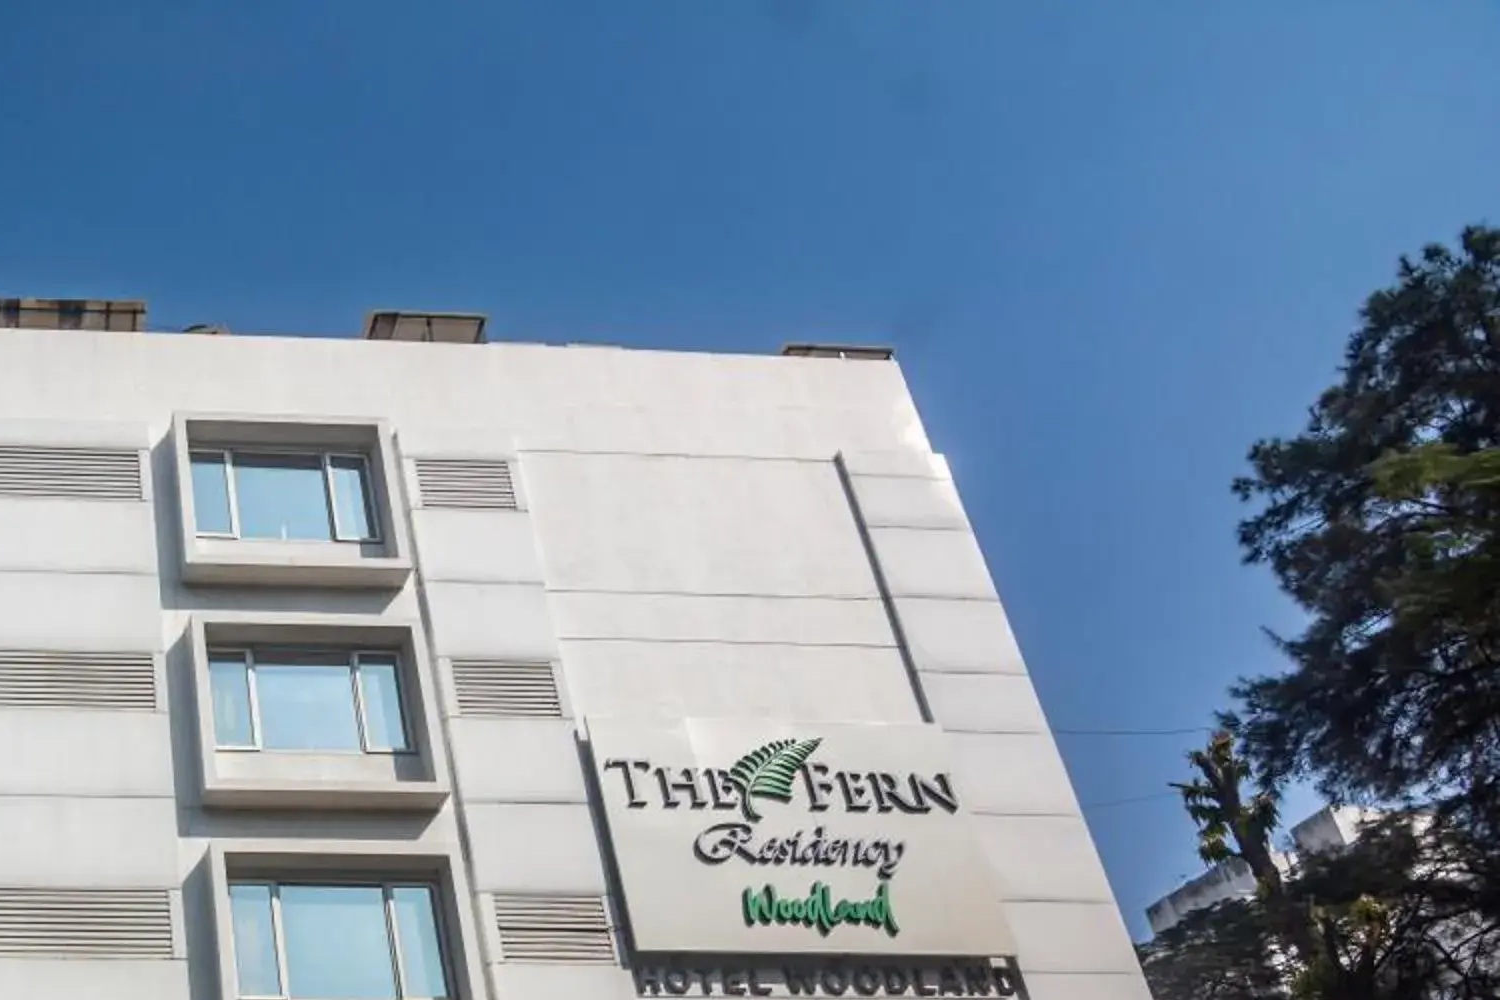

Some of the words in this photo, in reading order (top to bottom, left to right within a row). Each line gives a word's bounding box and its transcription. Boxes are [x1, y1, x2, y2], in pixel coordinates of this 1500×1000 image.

[604, 757, 743, 811] THE
[800, 763, 959, 815] FERN
[693, 823, 906, 880] Residency
[742, 881, 899, 937] Woodland
[634, 966, 773, 997] HOTEL
[781, 963, 1016, 997] WOODLAND
